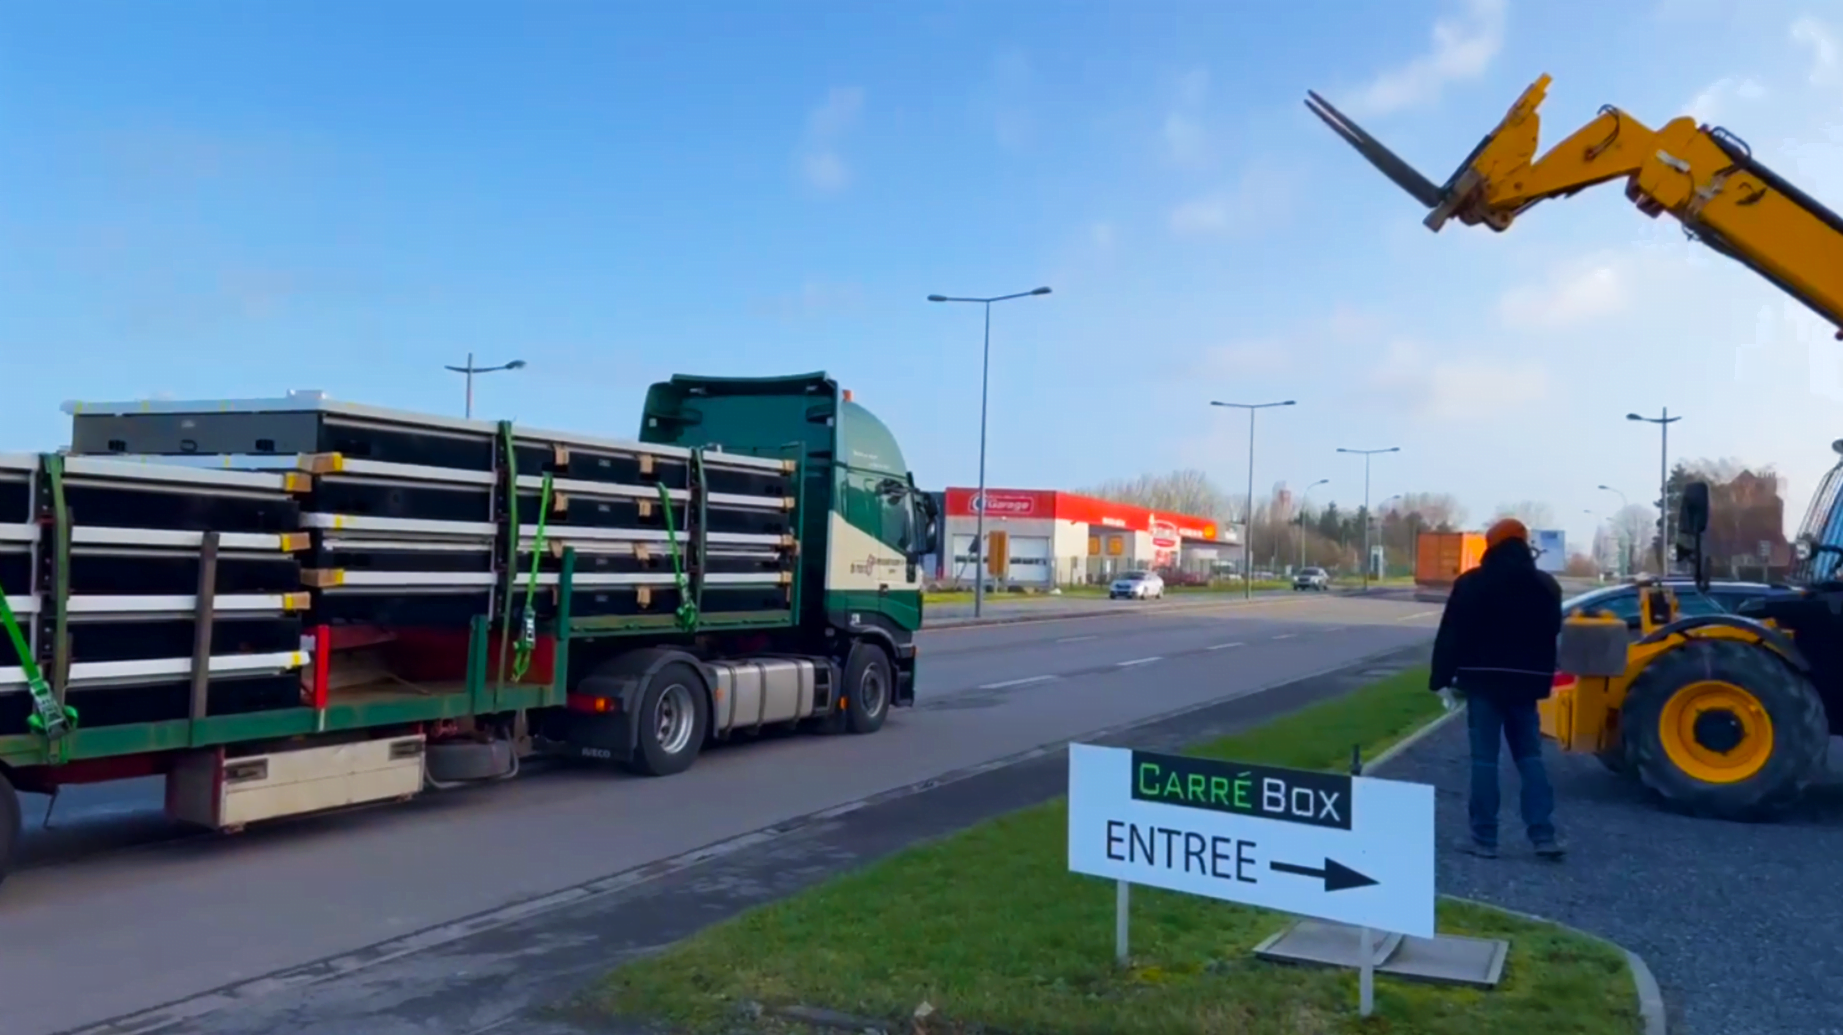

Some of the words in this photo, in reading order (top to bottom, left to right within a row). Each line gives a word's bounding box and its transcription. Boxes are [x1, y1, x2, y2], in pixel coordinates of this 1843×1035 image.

[1138, 762, 1253, 809] CARRÉ
[1261, 777, 1341, 822] BOX
[1106, 819, 1258, 884] ENTREE
